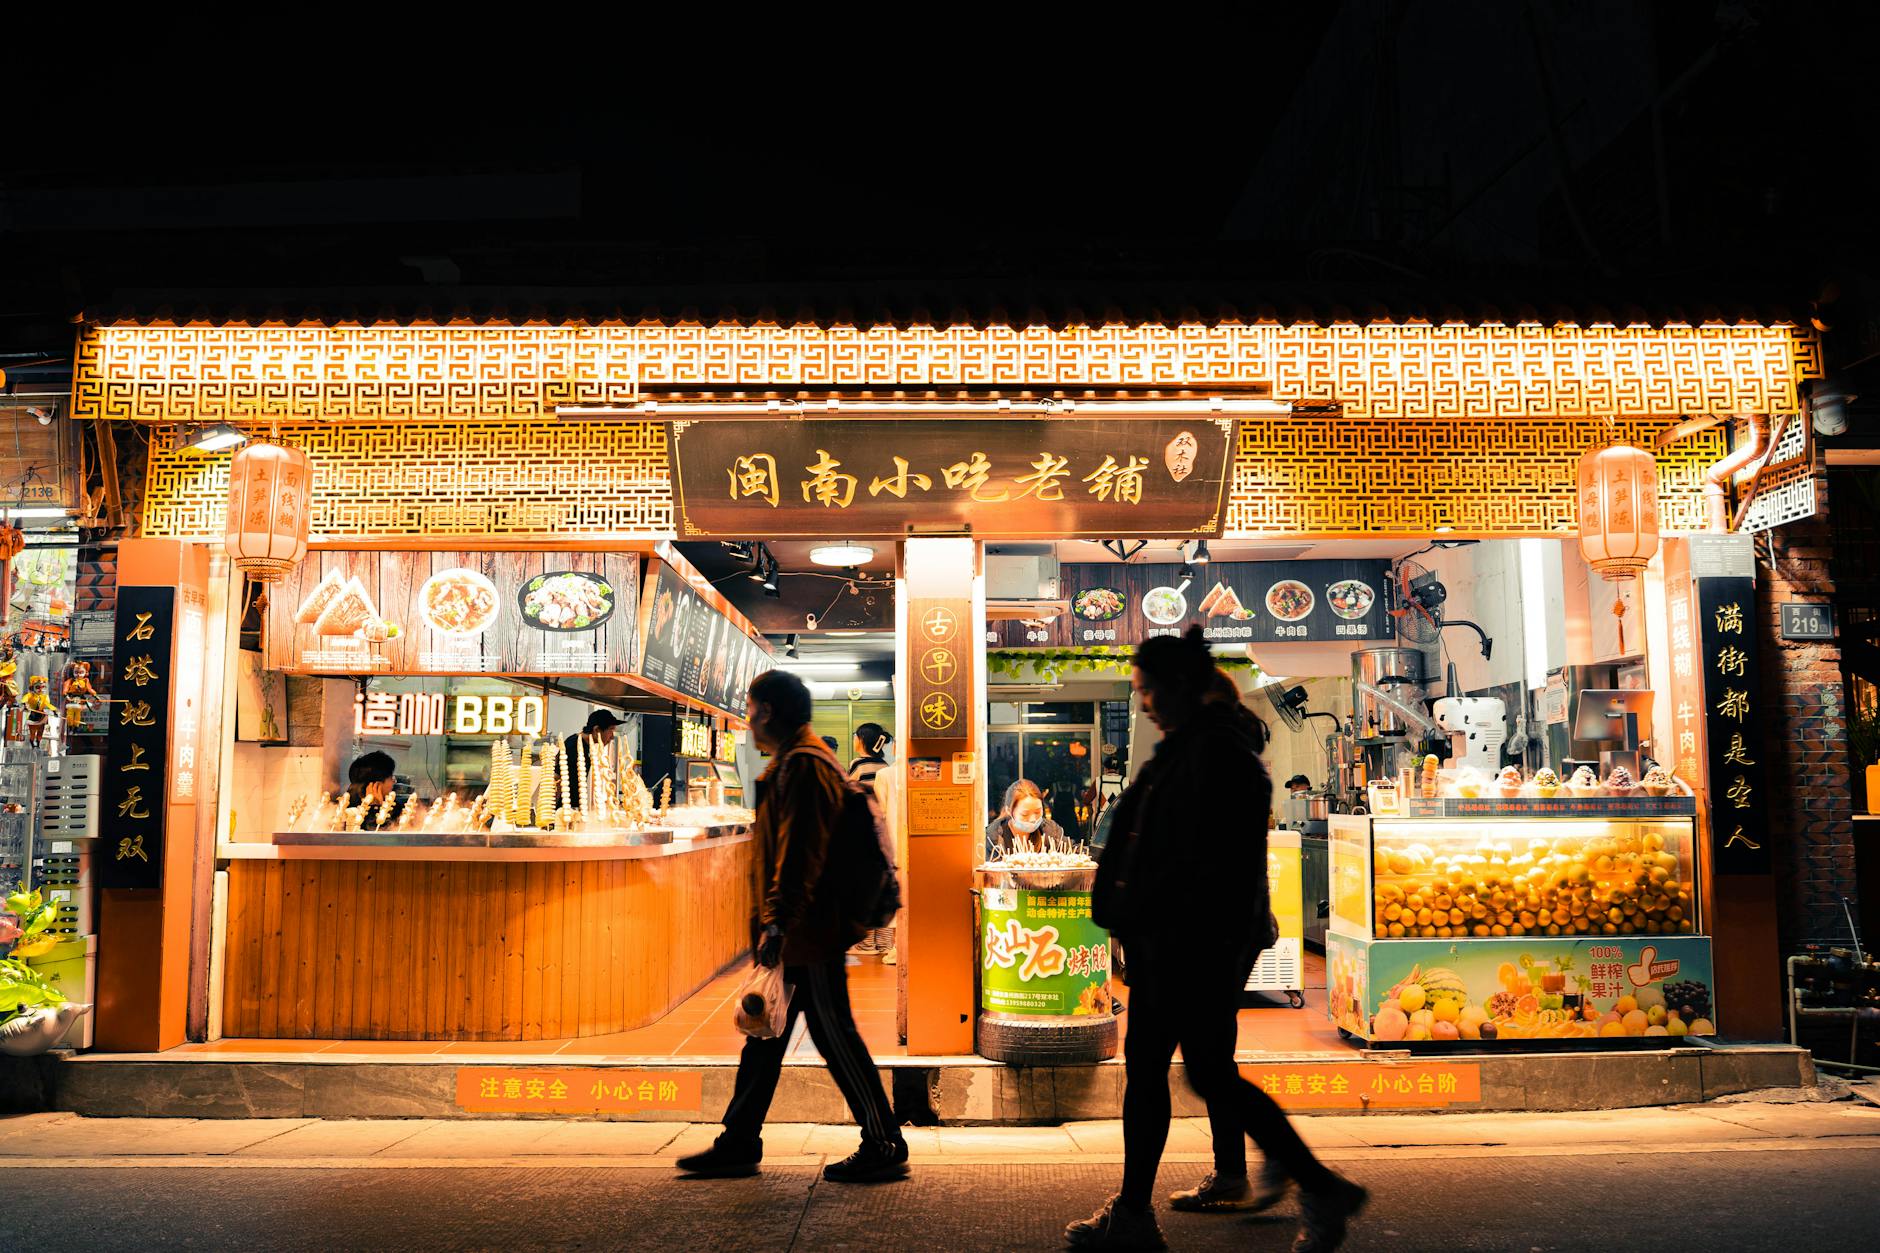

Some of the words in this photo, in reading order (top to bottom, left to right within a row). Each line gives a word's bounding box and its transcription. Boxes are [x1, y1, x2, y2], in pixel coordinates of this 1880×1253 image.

[278, 472, 297, 529] 面线糊
[728, 449, 1149, 509] 闽南小吃老铺
[1671, 597, 1692, 679] 面线糊
[923, 610, 953, 726] 古早味
[115, 611, 160, 864] 石塔地上无双
[455, 695, 544, 739] BBQ
[1714, 601, 1761, 849] 满街都是圣人
[1067, 944, 1107, 977] 烤肠
[1590, 946, 1624, 959] 100%
[1590, 963, 1623, 980] 鲜榨
[1591, 982, 1624, 999] 果汁
[479, 1077, 569, 1100] 注意安全
[590, 1079, 679, 1102] 小心台阶
[1260, 1073, 1350, 1095] 注意安全
[1371, 1072, 1458, 1095] 小心台阶
